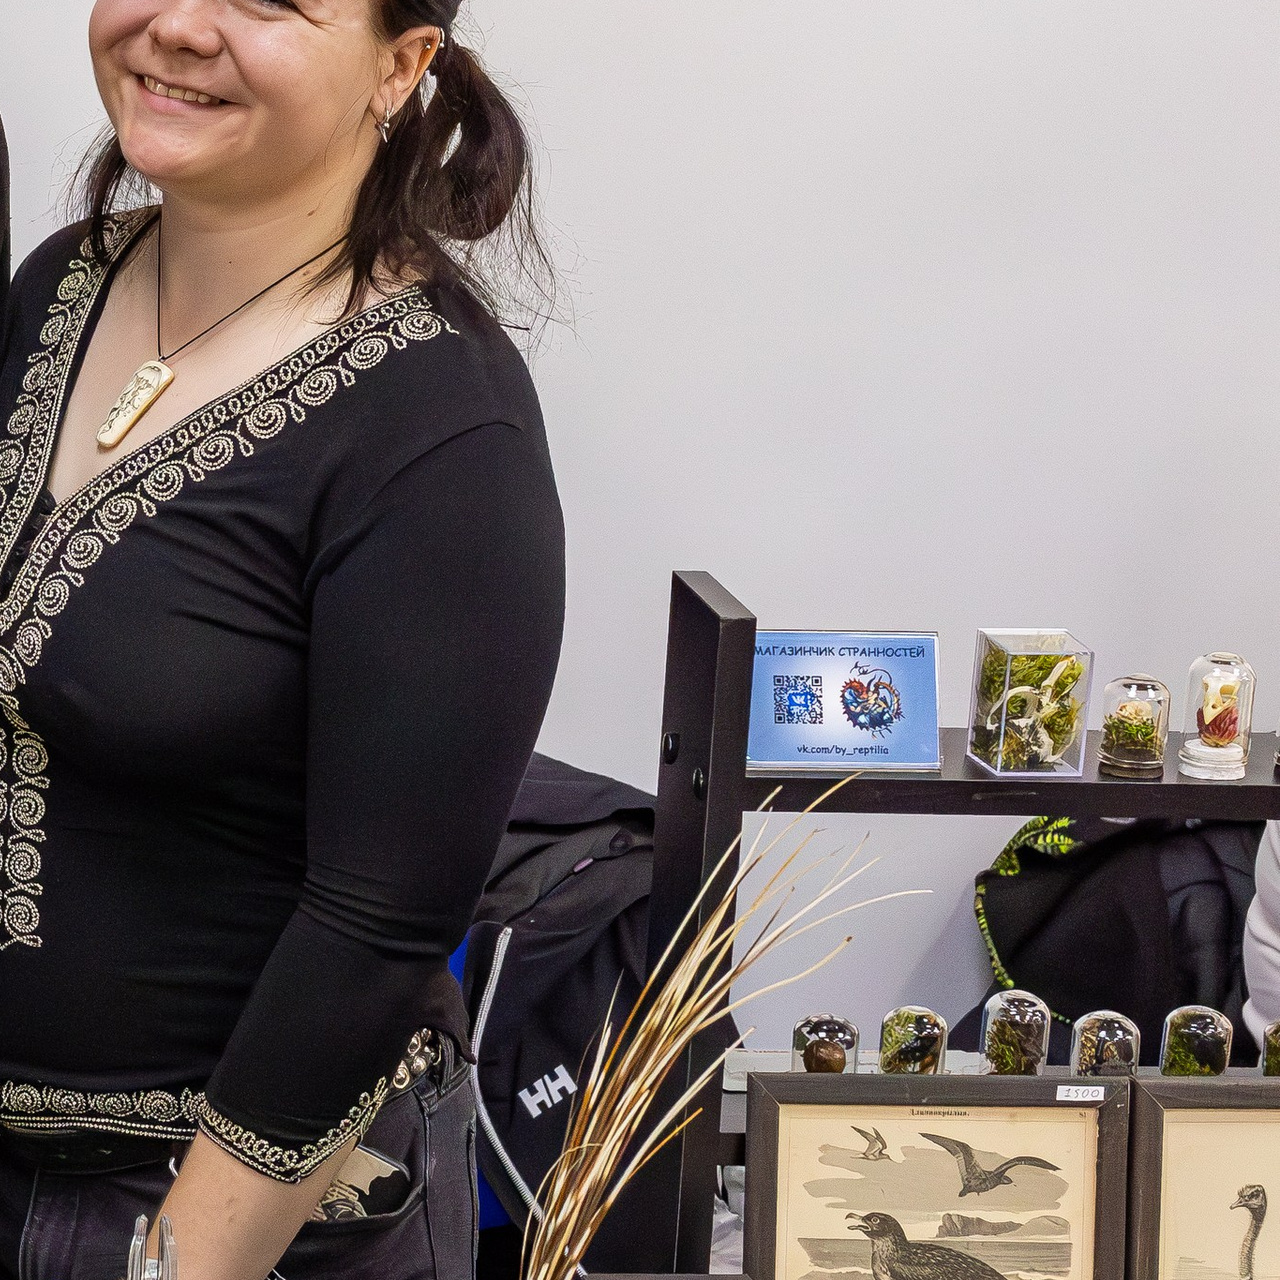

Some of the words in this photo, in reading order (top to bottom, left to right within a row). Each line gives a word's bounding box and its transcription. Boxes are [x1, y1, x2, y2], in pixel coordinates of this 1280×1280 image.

[754, 645, 835, 658] МАГАЗИНЧИК
[838, 644, 926, 659] СТРАННОСТЕЙ
[797, 743, 889, 757] vk.com/by_reptilia
[518, 1064, 578, 1119] HH
[1064, 1088, 1101, 1099] 1500
